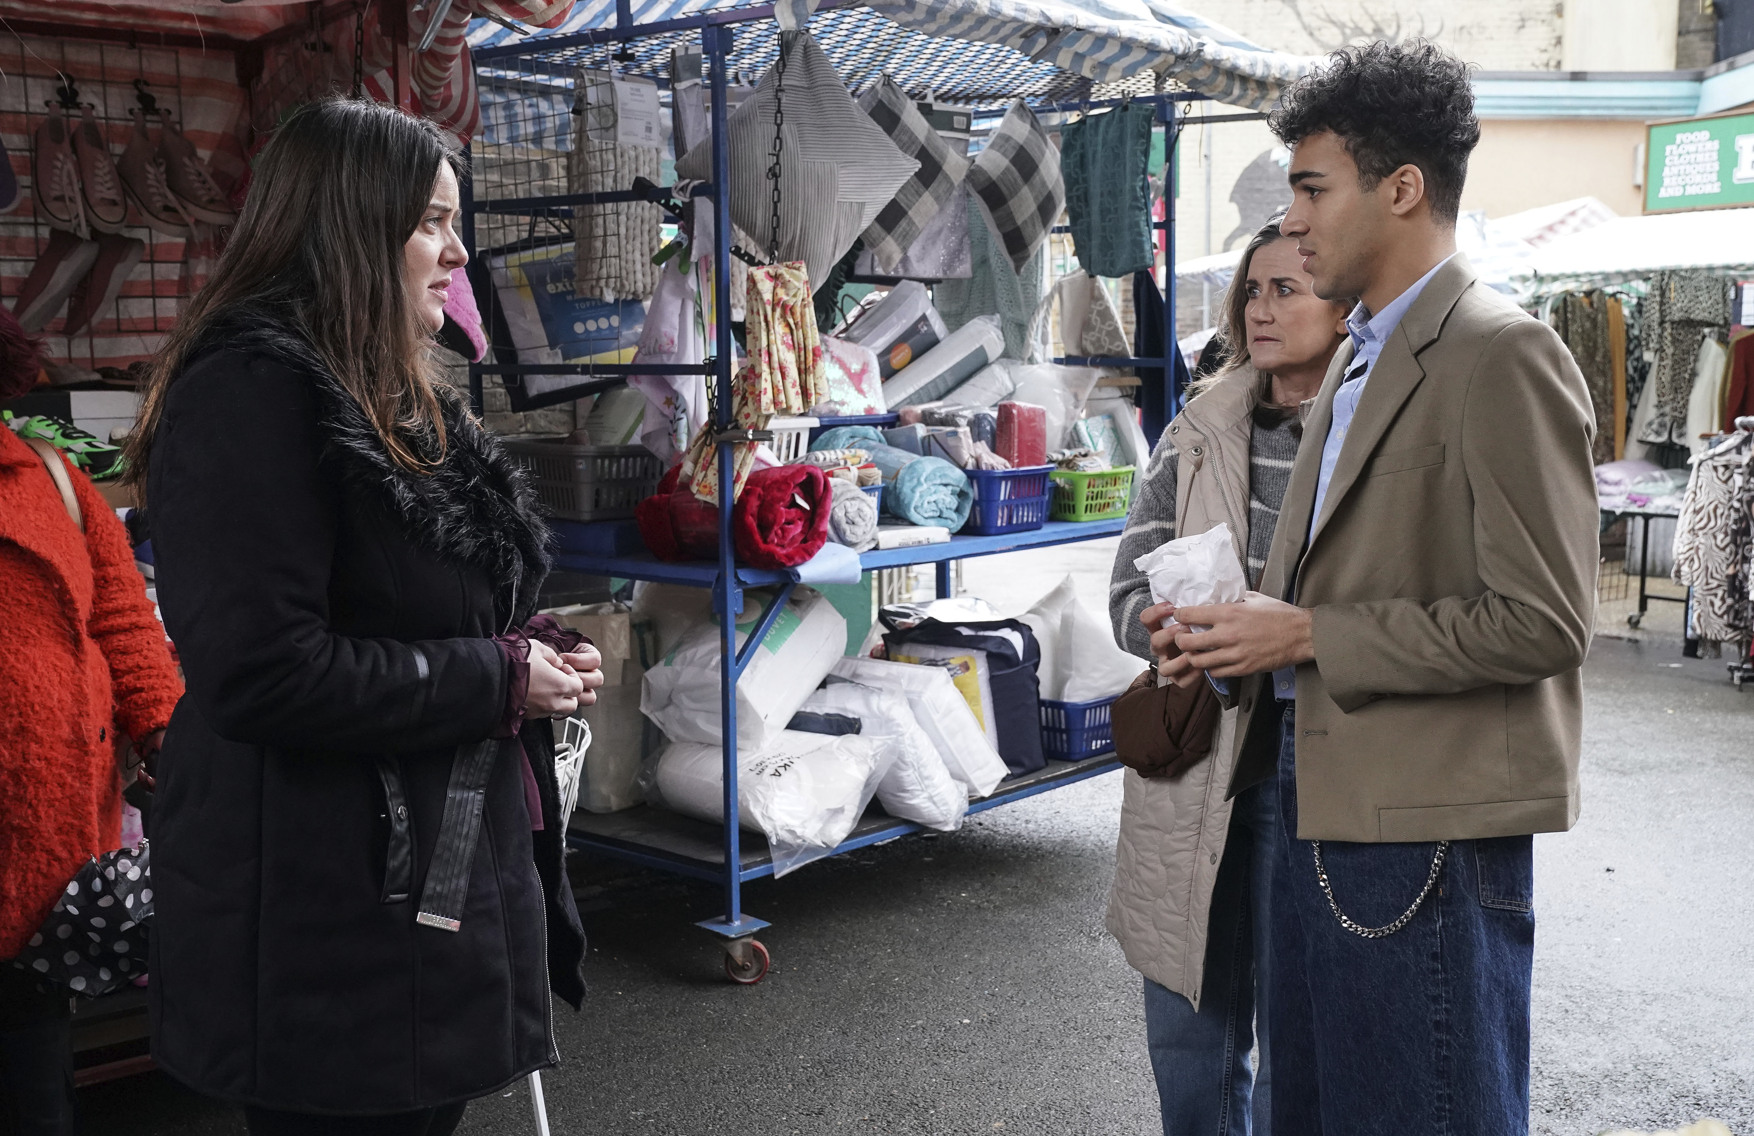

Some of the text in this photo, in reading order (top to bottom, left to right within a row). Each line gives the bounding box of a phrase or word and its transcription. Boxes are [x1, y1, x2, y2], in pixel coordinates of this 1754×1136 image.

[1675, 130, 1711, 145] FOOD
[1665, 139, 1720, 156] FLOWERS
[1665, 151, 1719, 166] CLOTHES
[1662, 161, 1720, 177] ANTIQUES
[1662, 172, 1718, 187] RECORDS
[1658, 181, 1722, 198] AND MORE
